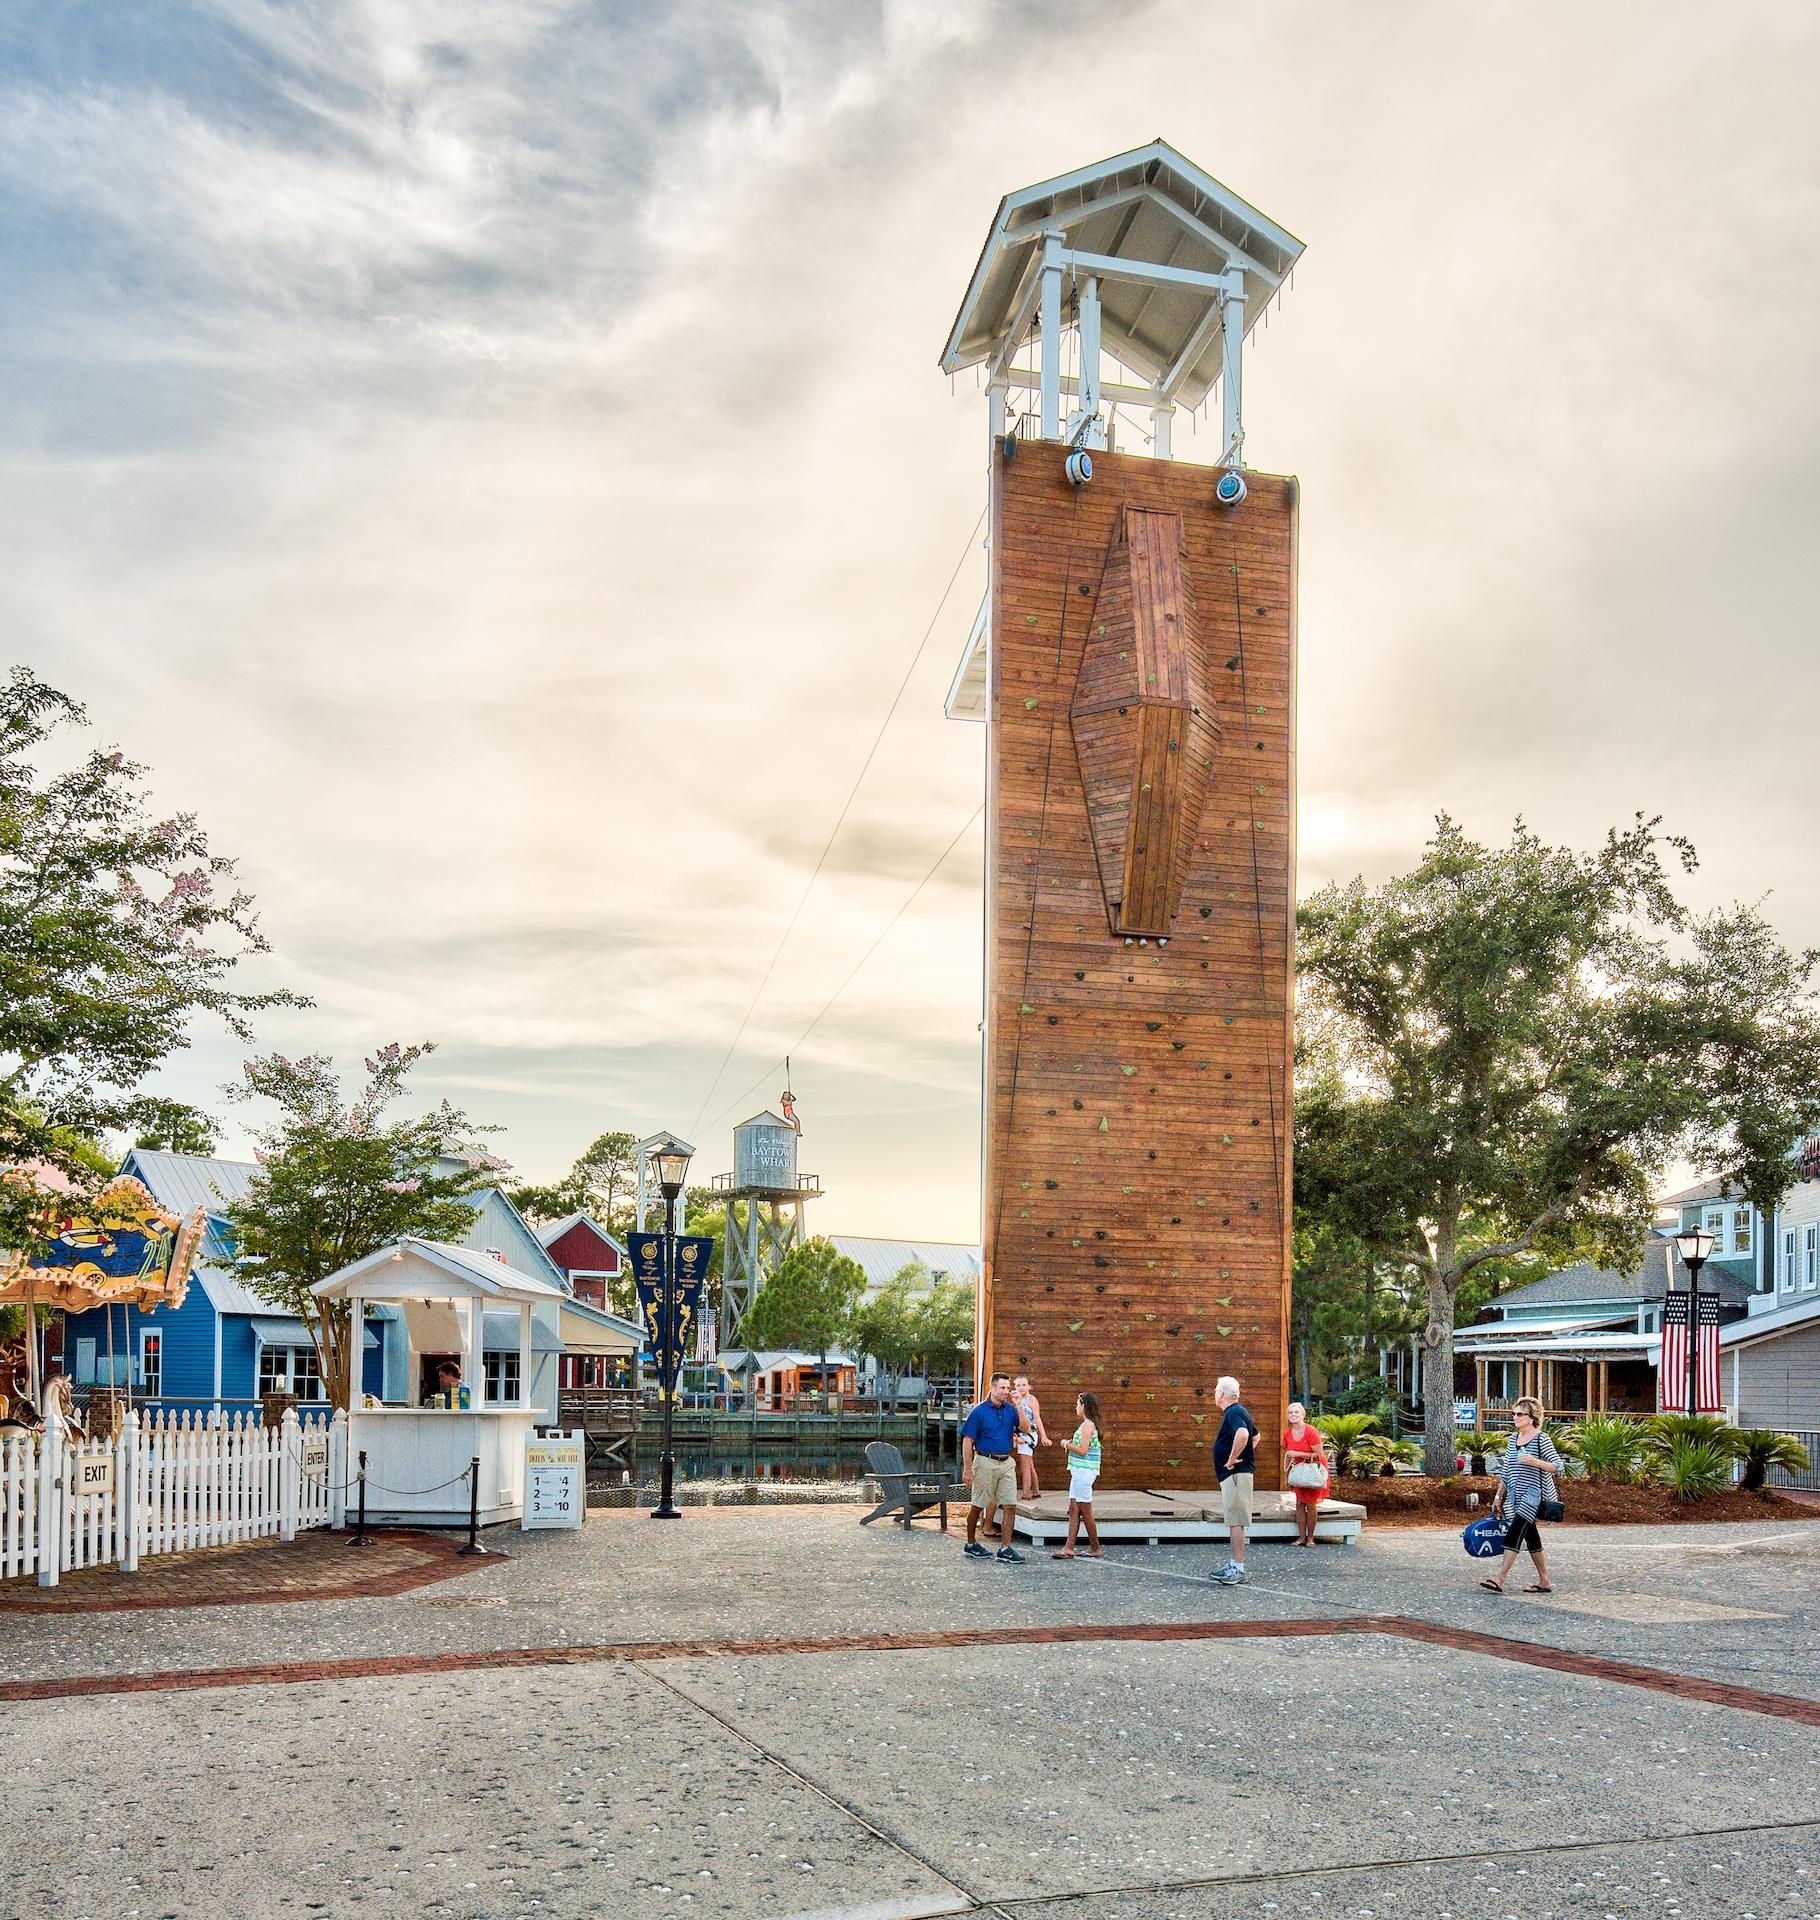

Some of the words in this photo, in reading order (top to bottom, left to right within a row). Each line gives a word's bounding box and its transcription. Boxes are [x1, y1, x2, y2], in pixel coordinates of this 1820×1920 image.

[137, 1231, 171, 1281] 24
[307, 1451, 325, 1466] ENTER
[84, 1465, 107, 1482] EXIT
[534, 1476, 540, 1486] 1
[533, 1489, 540, 1499] 2
[533, 1502, 540, 1511] 3
